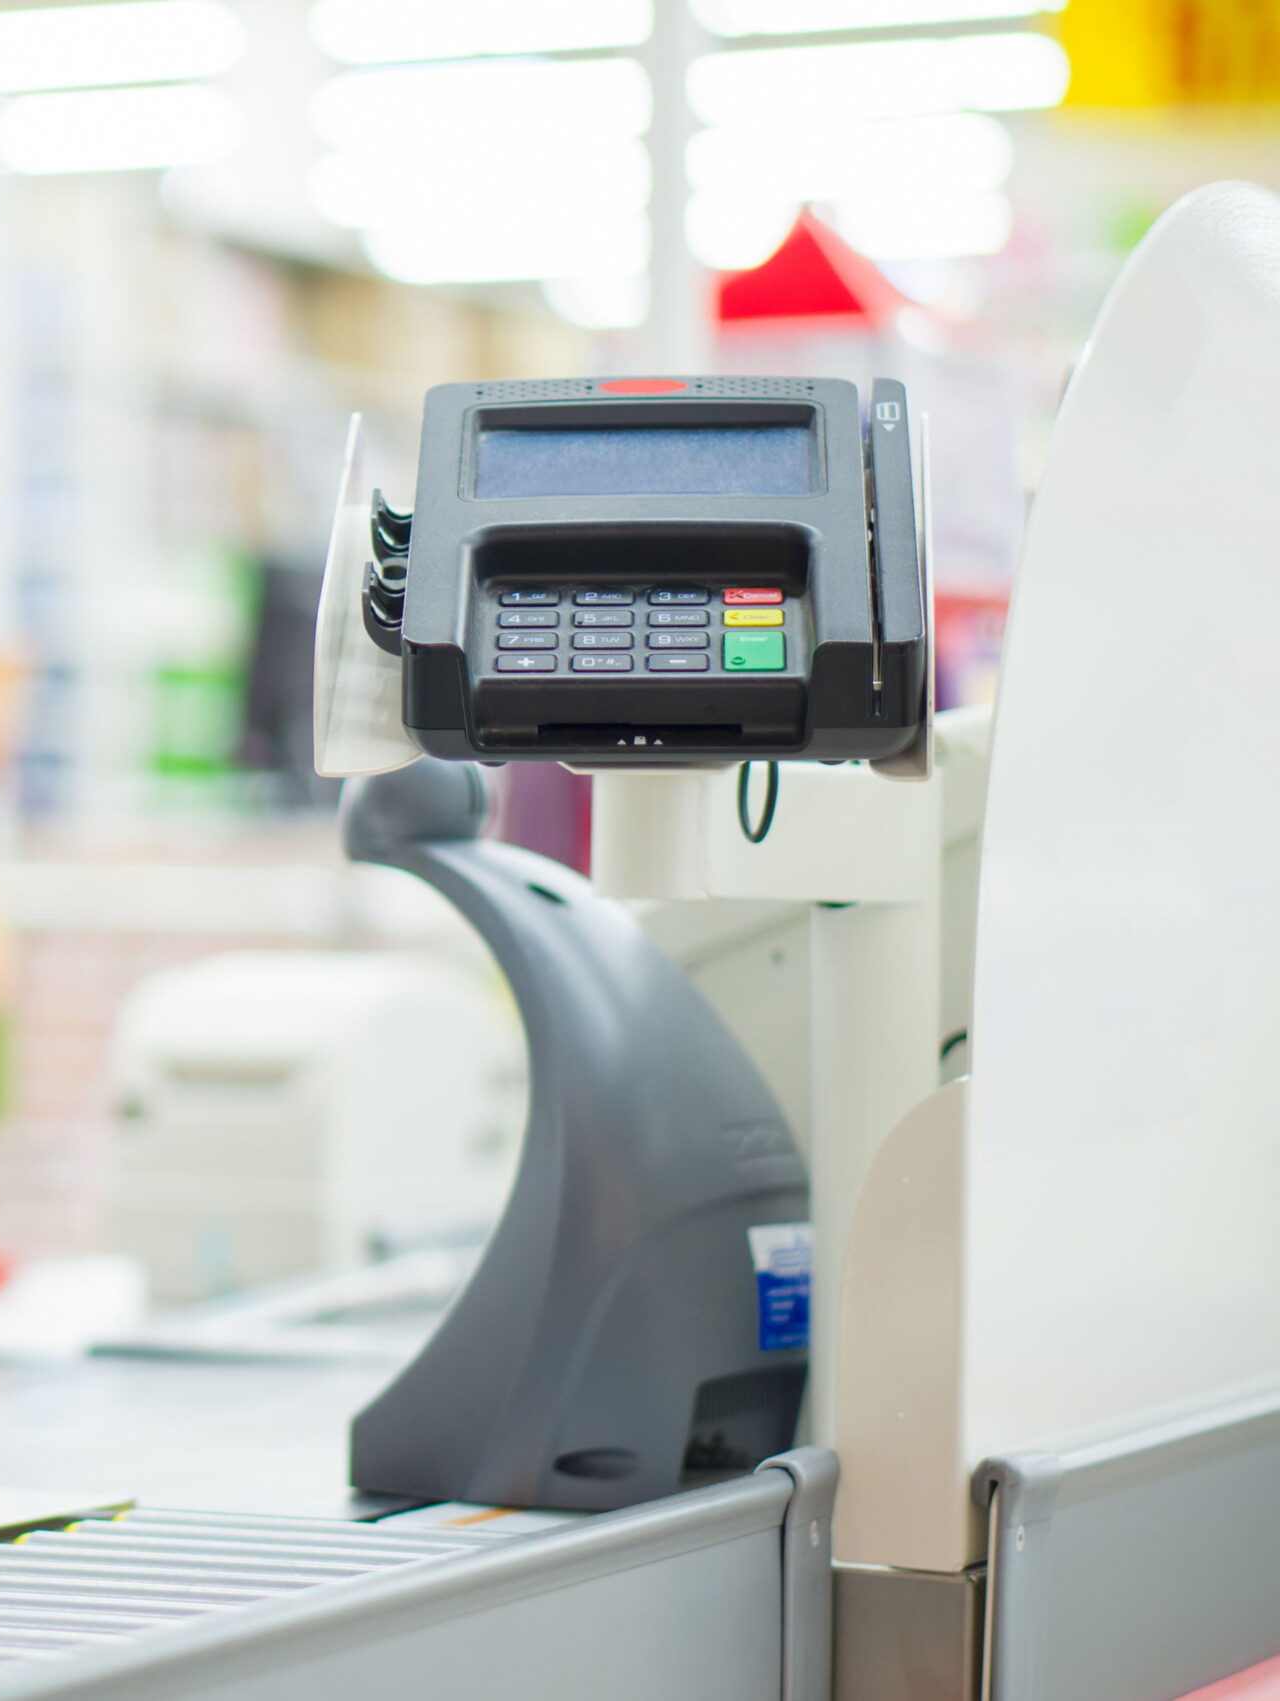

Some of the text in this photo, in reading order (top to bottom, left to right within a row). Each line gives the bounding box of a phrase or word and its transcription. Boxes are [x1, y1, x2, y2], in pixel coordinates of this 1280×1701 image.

[511, 592, 520, 601] 1
[585, 592, 598, 601] 2
[658, 592, 671, 601] 3
[507, 614, 521, 623] 4
[584, 614, 597, 623] 5
[658, 613, 671, 623] 6
[507, 635, 519, 644] 7
[583, 635, 596, 644] 8
[658, 635, 671, 644] 9
[582, 657, 595, 667] 0
